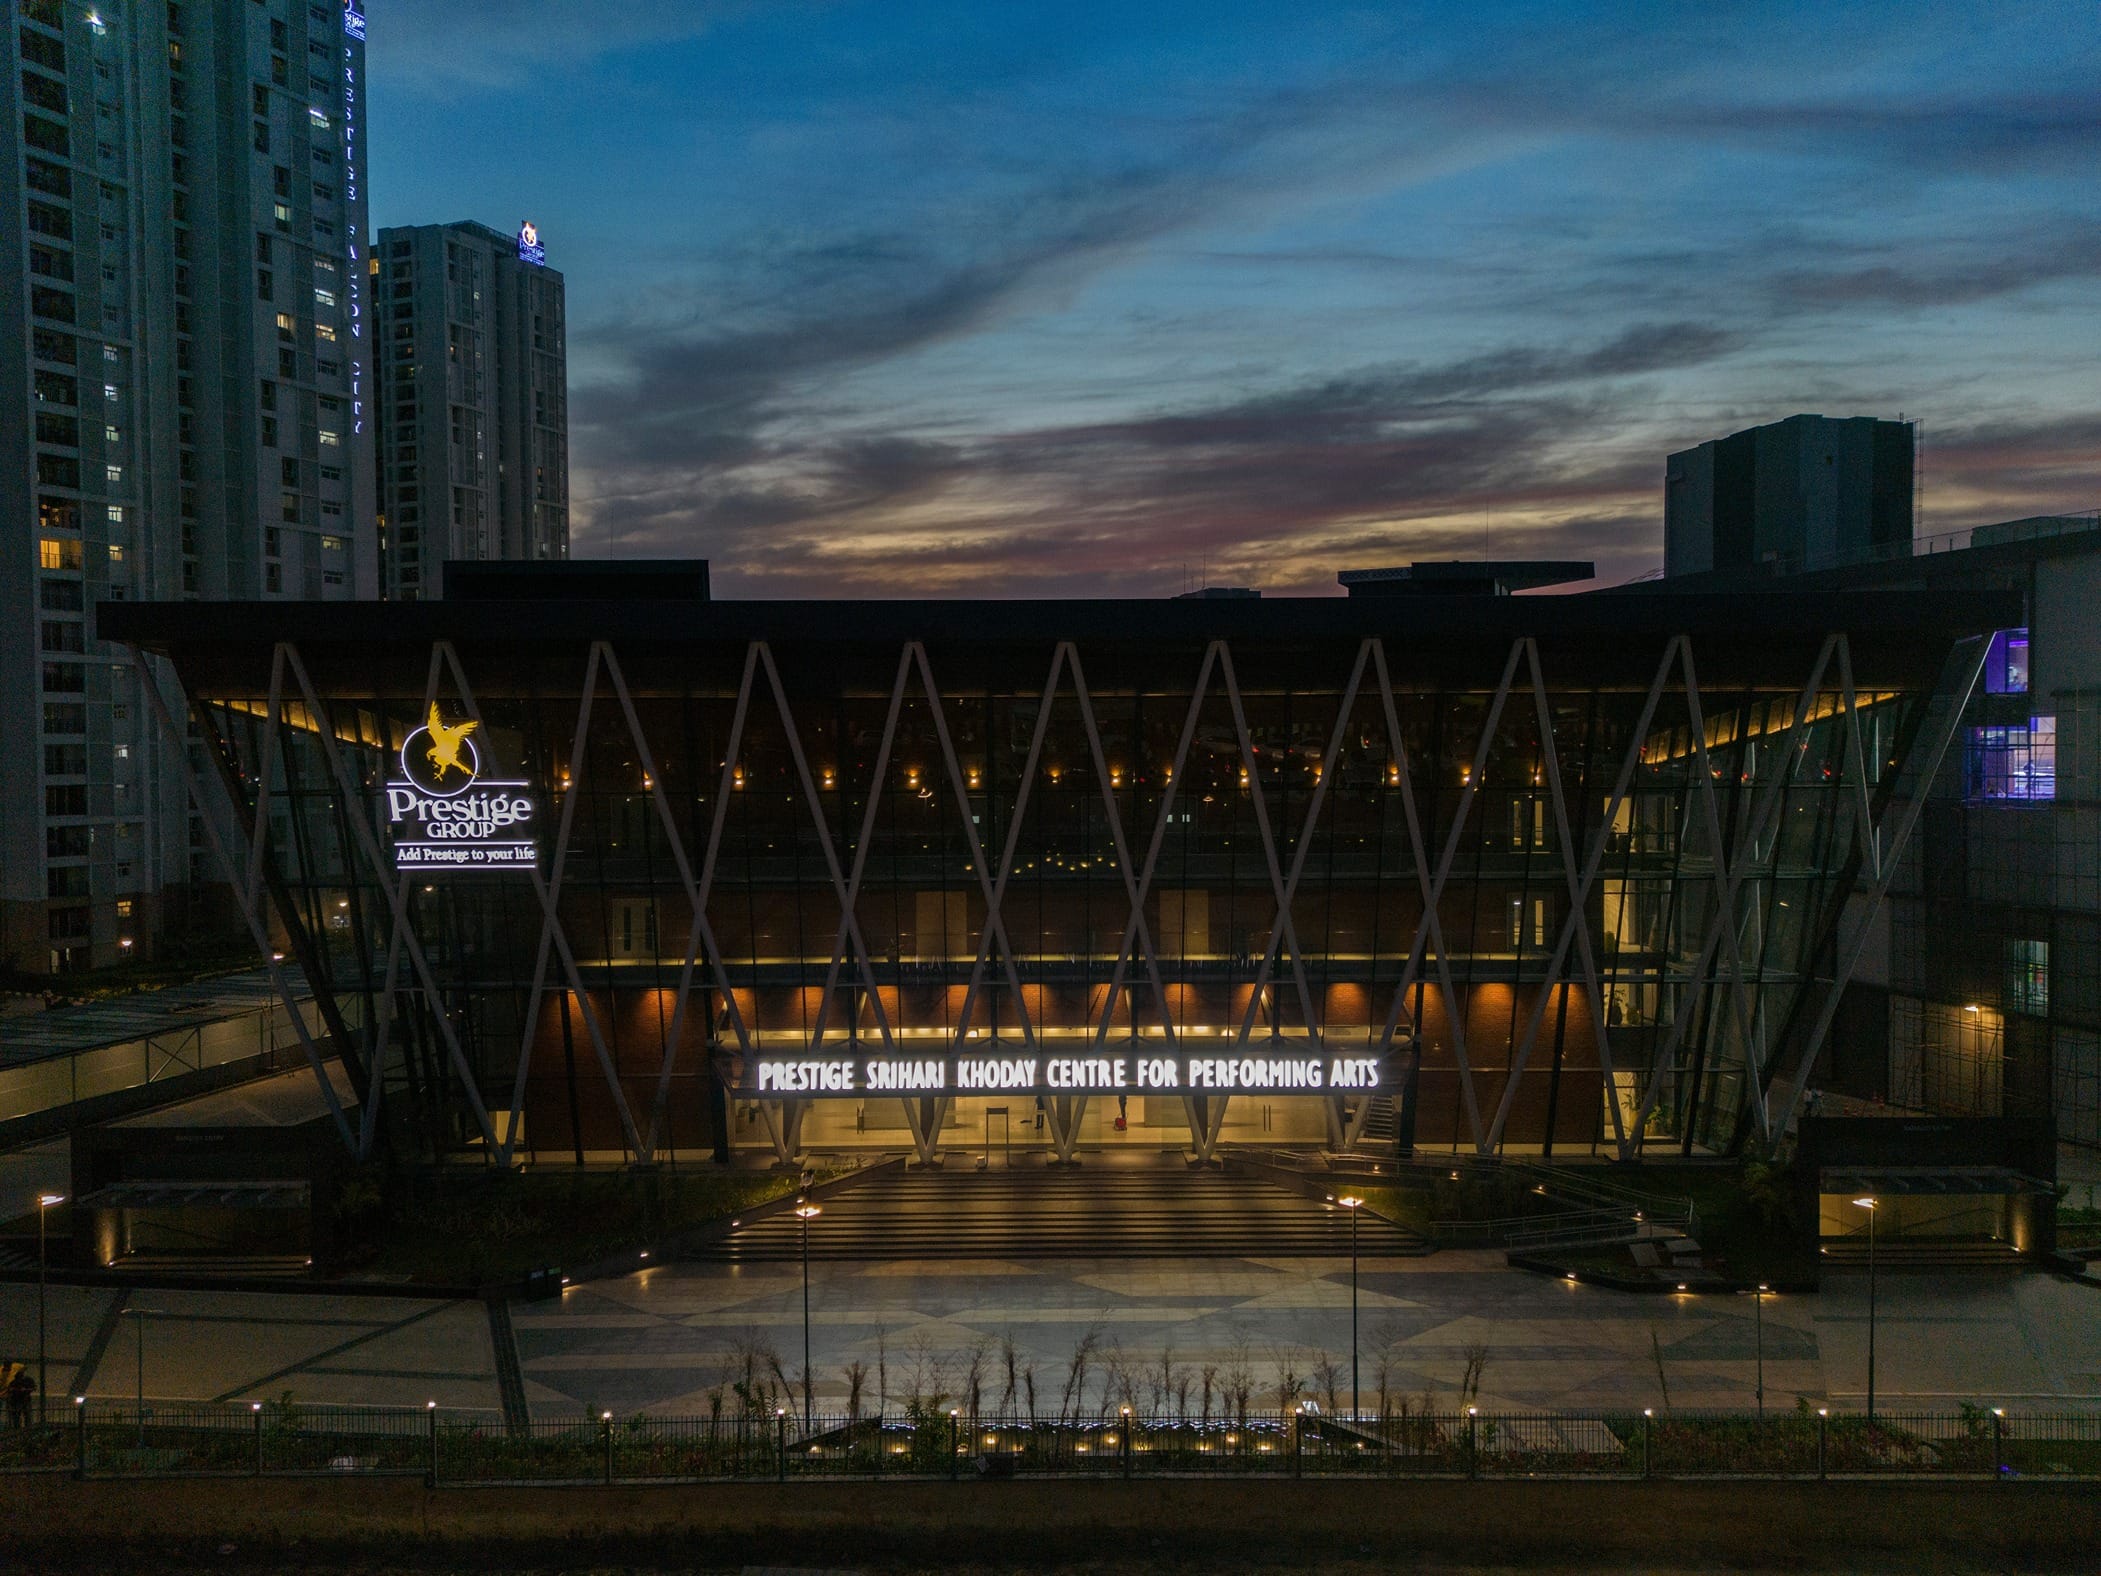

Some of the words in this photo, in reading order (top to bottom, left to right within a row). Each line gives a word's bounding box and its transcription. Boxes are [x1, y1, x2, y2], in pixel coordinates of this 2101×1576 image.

[387, 789, 531, 825] Prestige
[427, 822, 495, 838] GROUP
[397, 849, 421, 860] Add
[423, 848, 469, 863] Prestige
[472, 850, 484, 860] to
[487, 850, 513, 862] your
[515, 847, 536, 860] life
[759, 1062, 854, 1090] PRESTIGE
[866, 1061, 945, 1089] SRIHARI
[957, 1060, 1036, 1088] KHODAY
[1047, 1060, 1126, 1087] CENTRE
[1138, 1060, 1178, 1087] FOR
[1189, 1060, 1322, 1087] PERFORMING
[1330, 1059, 1379, 1087] ARTS
